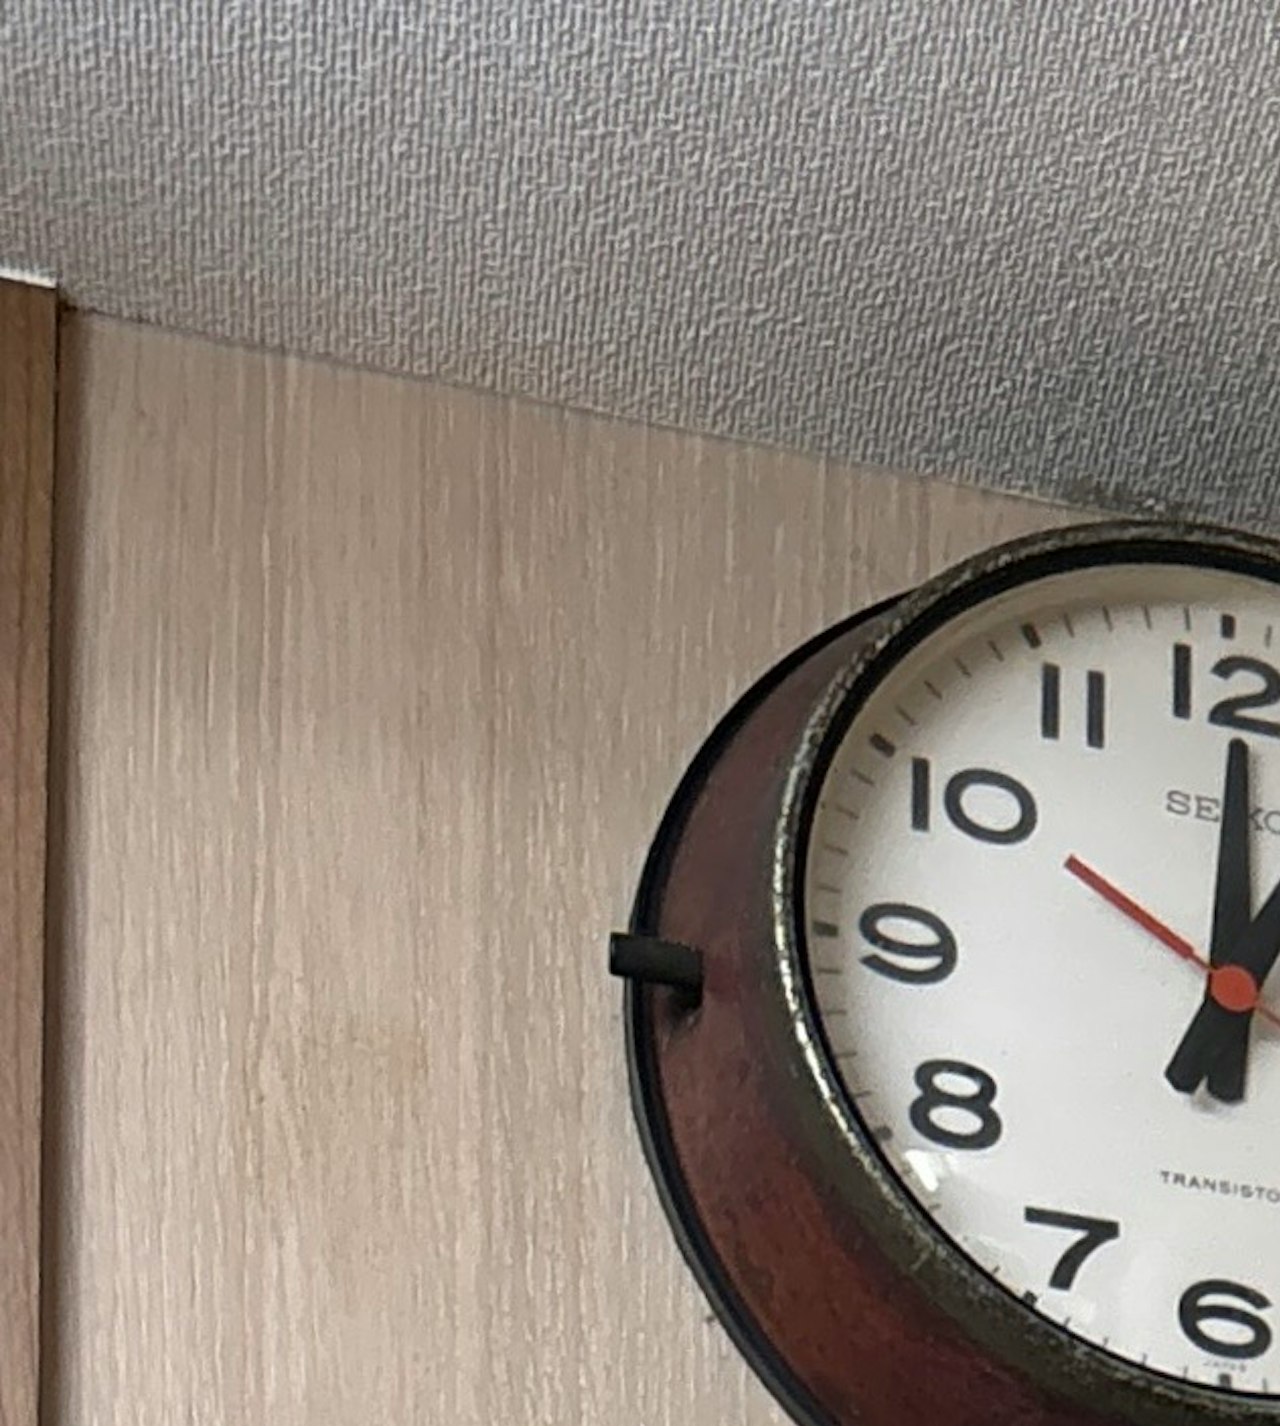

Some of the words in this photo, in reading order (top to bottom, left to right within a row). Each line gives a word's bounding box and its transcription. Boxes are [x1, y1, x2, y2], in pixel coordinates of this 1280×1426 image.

[1040, 662, 1107, 749] 11
[909, 756, 1039, 845] 10
[858, 902, 958, 985] 9
[908, 1058, 1003, 1152] 8
[1022, 1204, 1120, 1292] 7
[1177, 1276, 1273, 1360] 6
